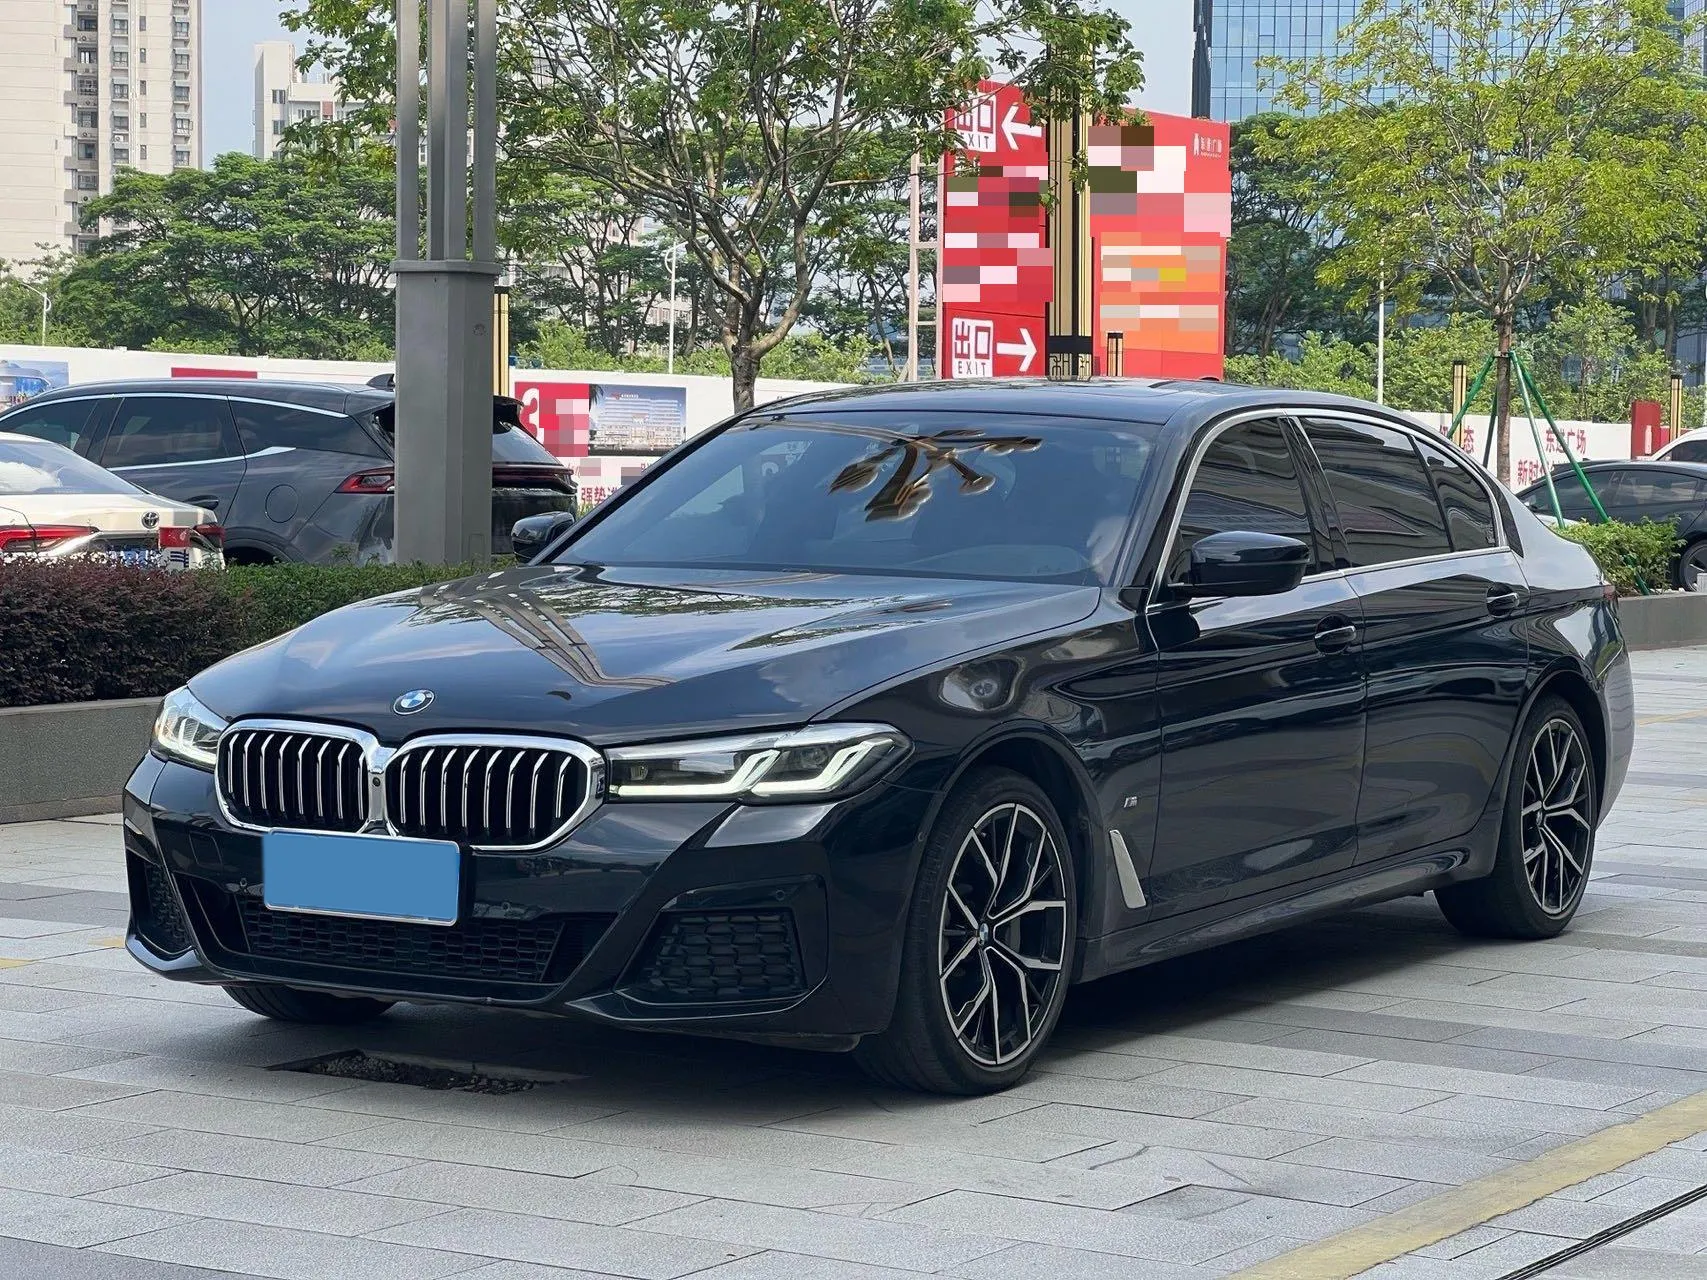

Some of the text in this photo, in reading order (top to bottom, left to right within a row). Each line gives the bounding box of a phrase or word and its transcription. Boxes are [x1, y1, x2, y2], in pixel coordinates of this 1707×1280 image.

[960, 133, 989, 149] XIT
[955, 321, 990, 359] 出口
[958, 361, 986, 376] EXIT
